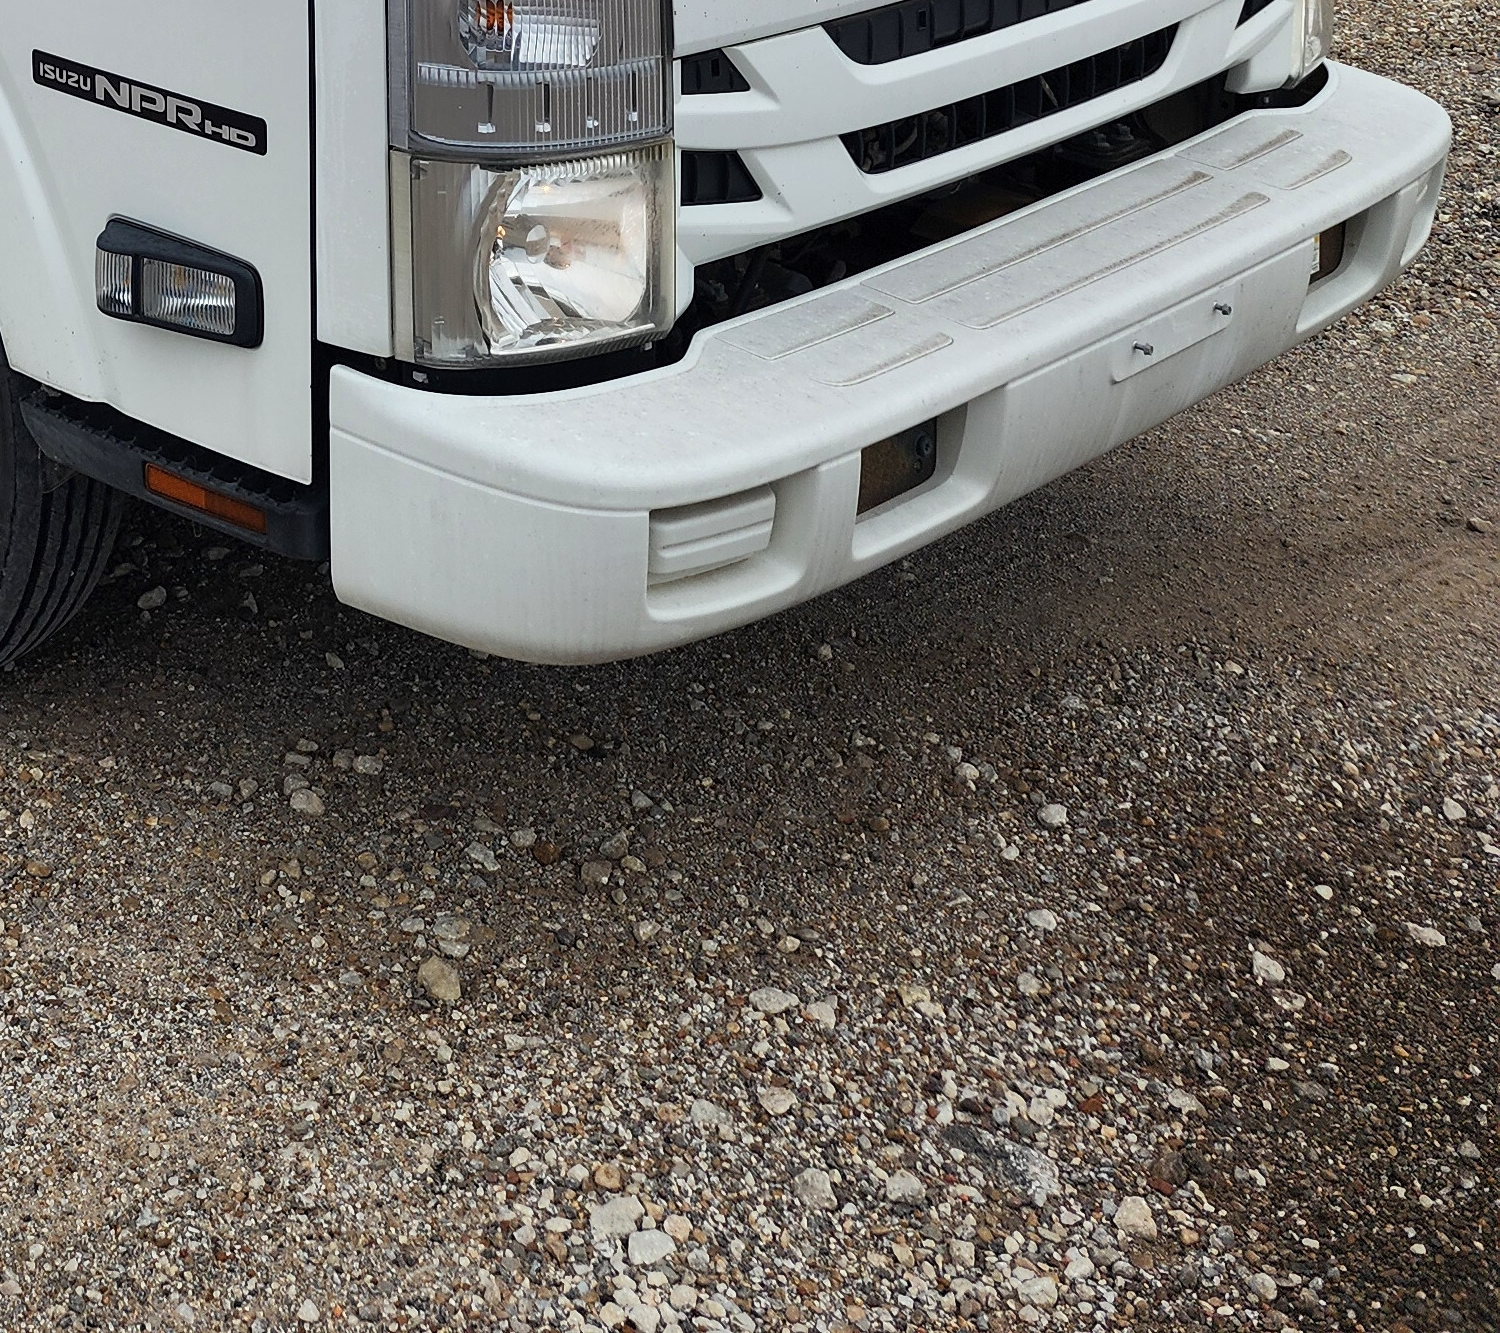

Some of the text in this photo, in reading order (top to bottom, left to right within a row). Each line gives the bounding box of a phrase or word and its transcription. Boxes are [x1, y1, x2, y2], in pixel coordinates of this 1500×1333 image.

[39, 61, 256, 148] ISUZU NPR HD
